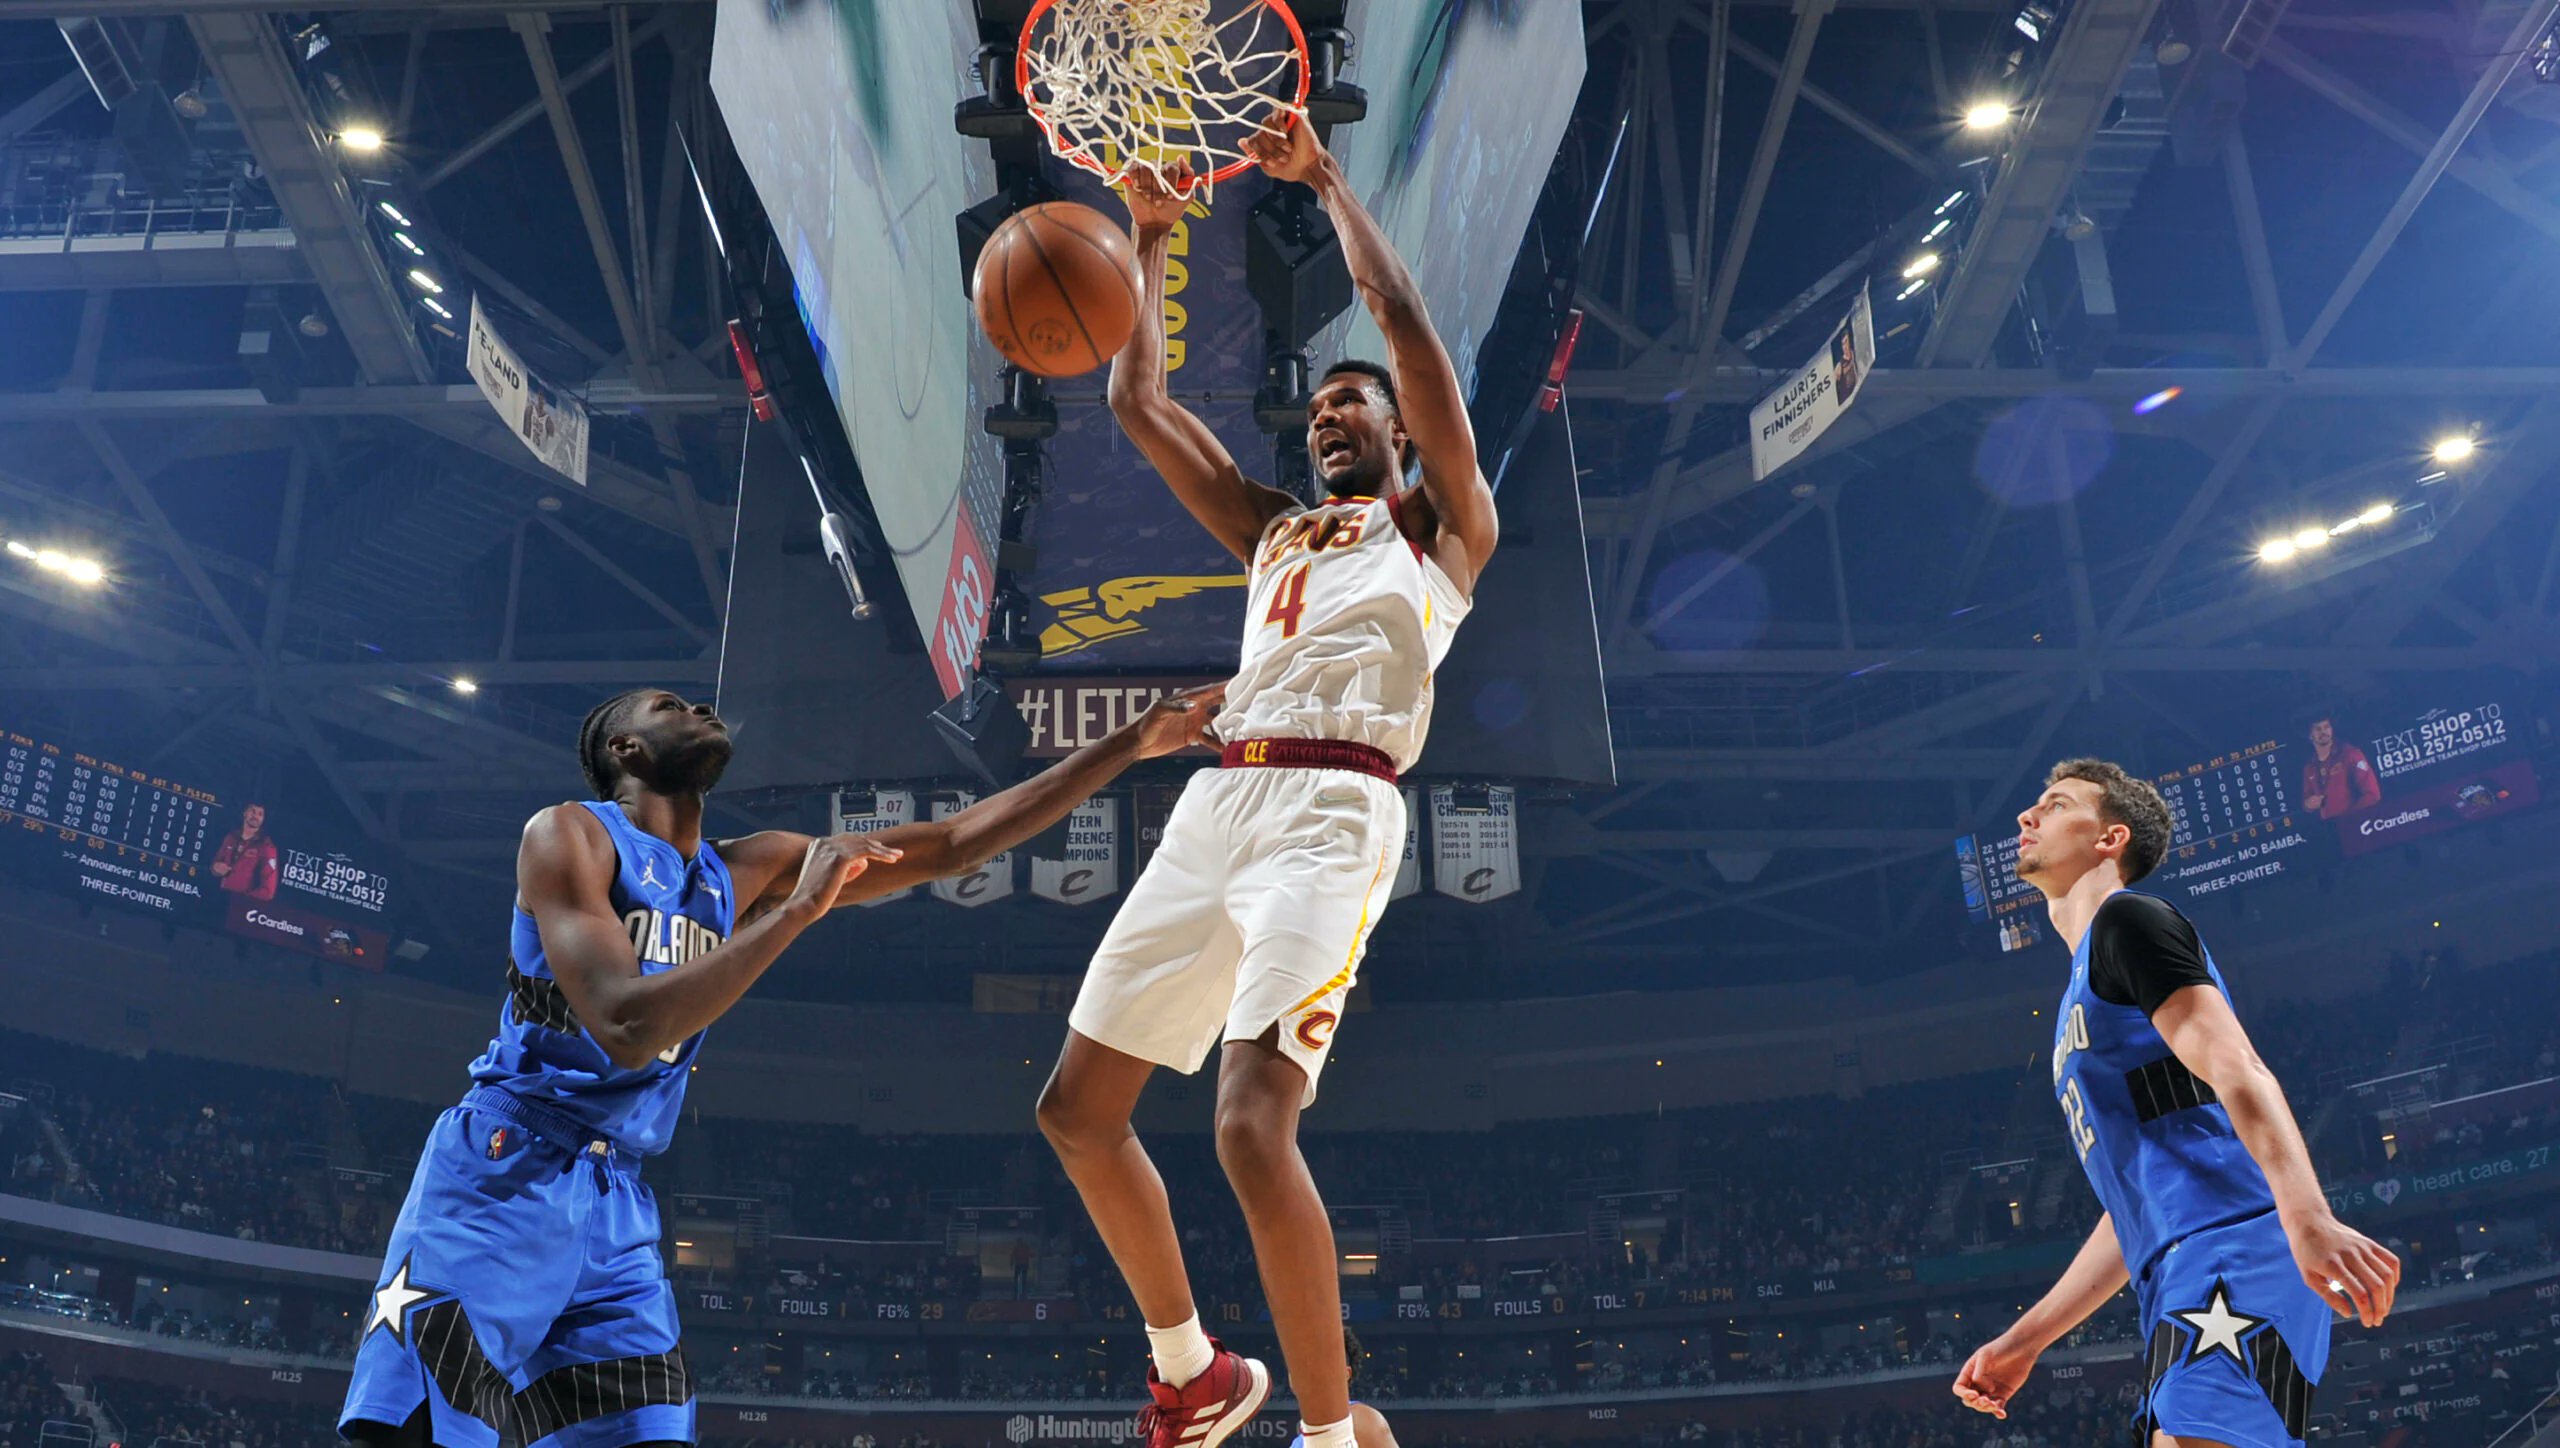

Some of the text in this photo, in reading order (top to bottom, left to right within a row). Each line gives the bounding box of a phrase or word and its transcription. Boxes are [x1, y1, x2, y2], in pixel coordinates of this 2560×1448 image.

[1762, 375, 1831, 440] FINNISHERS
[1774, 368, 1818, 413] LAURI'S
[1260, 513, 1364, 574] CAVS
[1263, 559, 1311, 640] 4
[1016, 688, 1184, 748] #LETE
[2371, 703, 2501, 754] TEXT SHOP TO
[1244, 741, 1269, 763] CLE
[2376, 719, 2506, 771] (833) 257-0512
[2380, 734, 2507, 779] FOR EXCLUSIVE TEAM SHOP DEALS
[1071, 815, 1102, 828] TERN
[1142, 827, 1165, 841] CHA
[2373, 808, 2430, 832] Cardless
[1062, 848, 1110, 861] MPIONS
[1067, 832, 1113, 845] ERENCE
[1997, 837, 2021, 850] WAGN
[2000, 848, 2020, 861] CART
[79, 853, 136, 879] Announcer:
[138, 871, 158, 884] MO
[287, 849, 388, 891] TEXT SHOP TO
[2179, 854, 2236, 879] Announcer:
[2238, 846, 2258, 861] MO
[2187, 861, 2285, 897] THREE-POINTER.
[80, 875, 174, 910] THREE-POINTER.
[283, 864, 385, 905] (833) 257-0512
[294, 881, 327, 897] EXCLUSIVE
[257, 914, 304, 936] Cardless
[1996, 901, 2016, 915] TEAM
[623, 908, 728, 965] ORLAND
[2060, 1077, 2096, 1165] 22
[2332, 1188, 2365, 1212] ry's
[2413, 1167, 2464, 1193] heart
[2526, 1147, 2549, 1169] 27
[700, 1294, 732, 1310] TOL:
[743, 1296, 753, 1312] 7
[780, 1300, 829, 1316] FOULS
[877, 1303, 910, 1319] FG%
[920, 1303, 943, 1319] 29
[1035, 1304, 1047, 1320] 6
[1398, 1303, 1430, 1318] FG%
[1438, 1303, 1462, 1318] 43
[1494, 1300, 1542, 1316] FOULS
[1553, 1297, 1564, 1313] 0
[1593, 1294, 1626, 1310] TOL:
[1634, 1291, 1646, 1308] 7
[1712, 1287, 1733, 1302] PM
[1757, 1284, 1783, 1297] SAC
[1813, 1280, 1836, 1293] MIA
